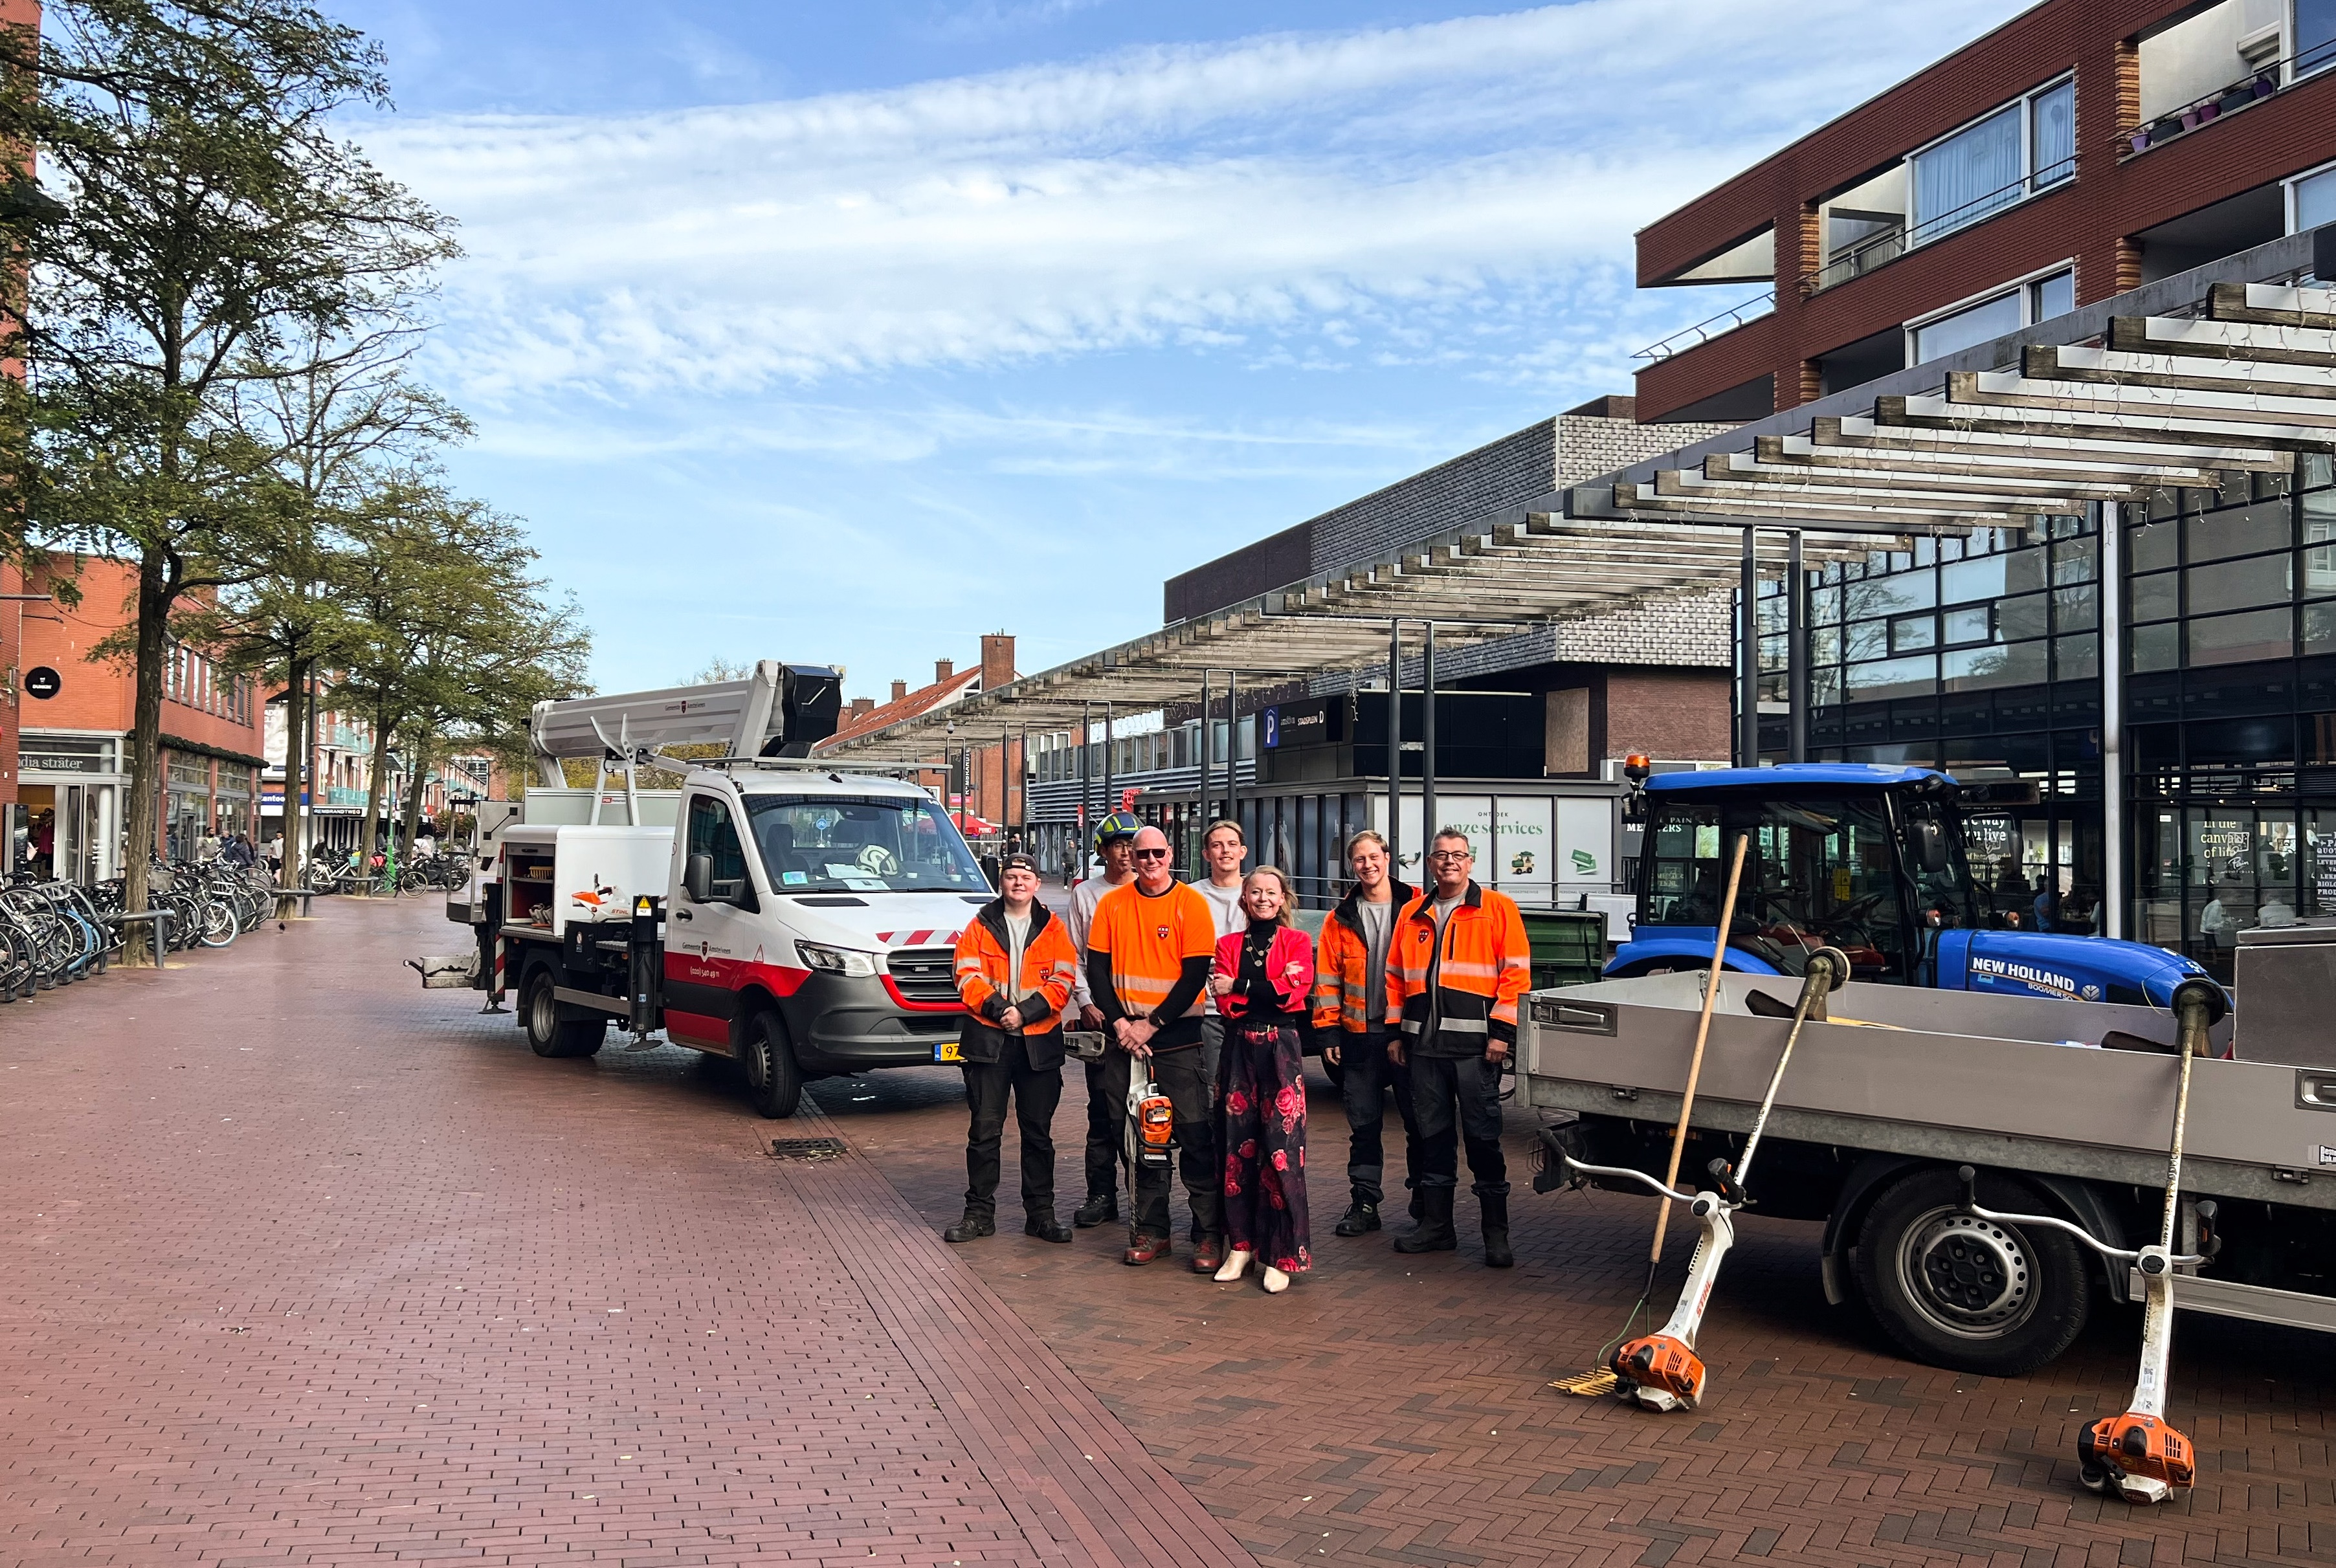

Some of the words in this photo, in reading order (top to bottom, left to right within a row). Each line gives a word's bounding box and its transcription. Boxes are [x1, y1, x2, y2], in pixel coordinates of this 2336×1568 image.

[1267, 715, 1274, 744] P
[1319, 710, 1324, 724] D
[41, 756, 83, 769] sträter
[1334, 819, 1354, 834] hme
[1973, 957, 2005, 974] NEW
[2008, 963, 2075, 992] HOLLAND
[1696, 1280, 1713, 1319] STIHL
